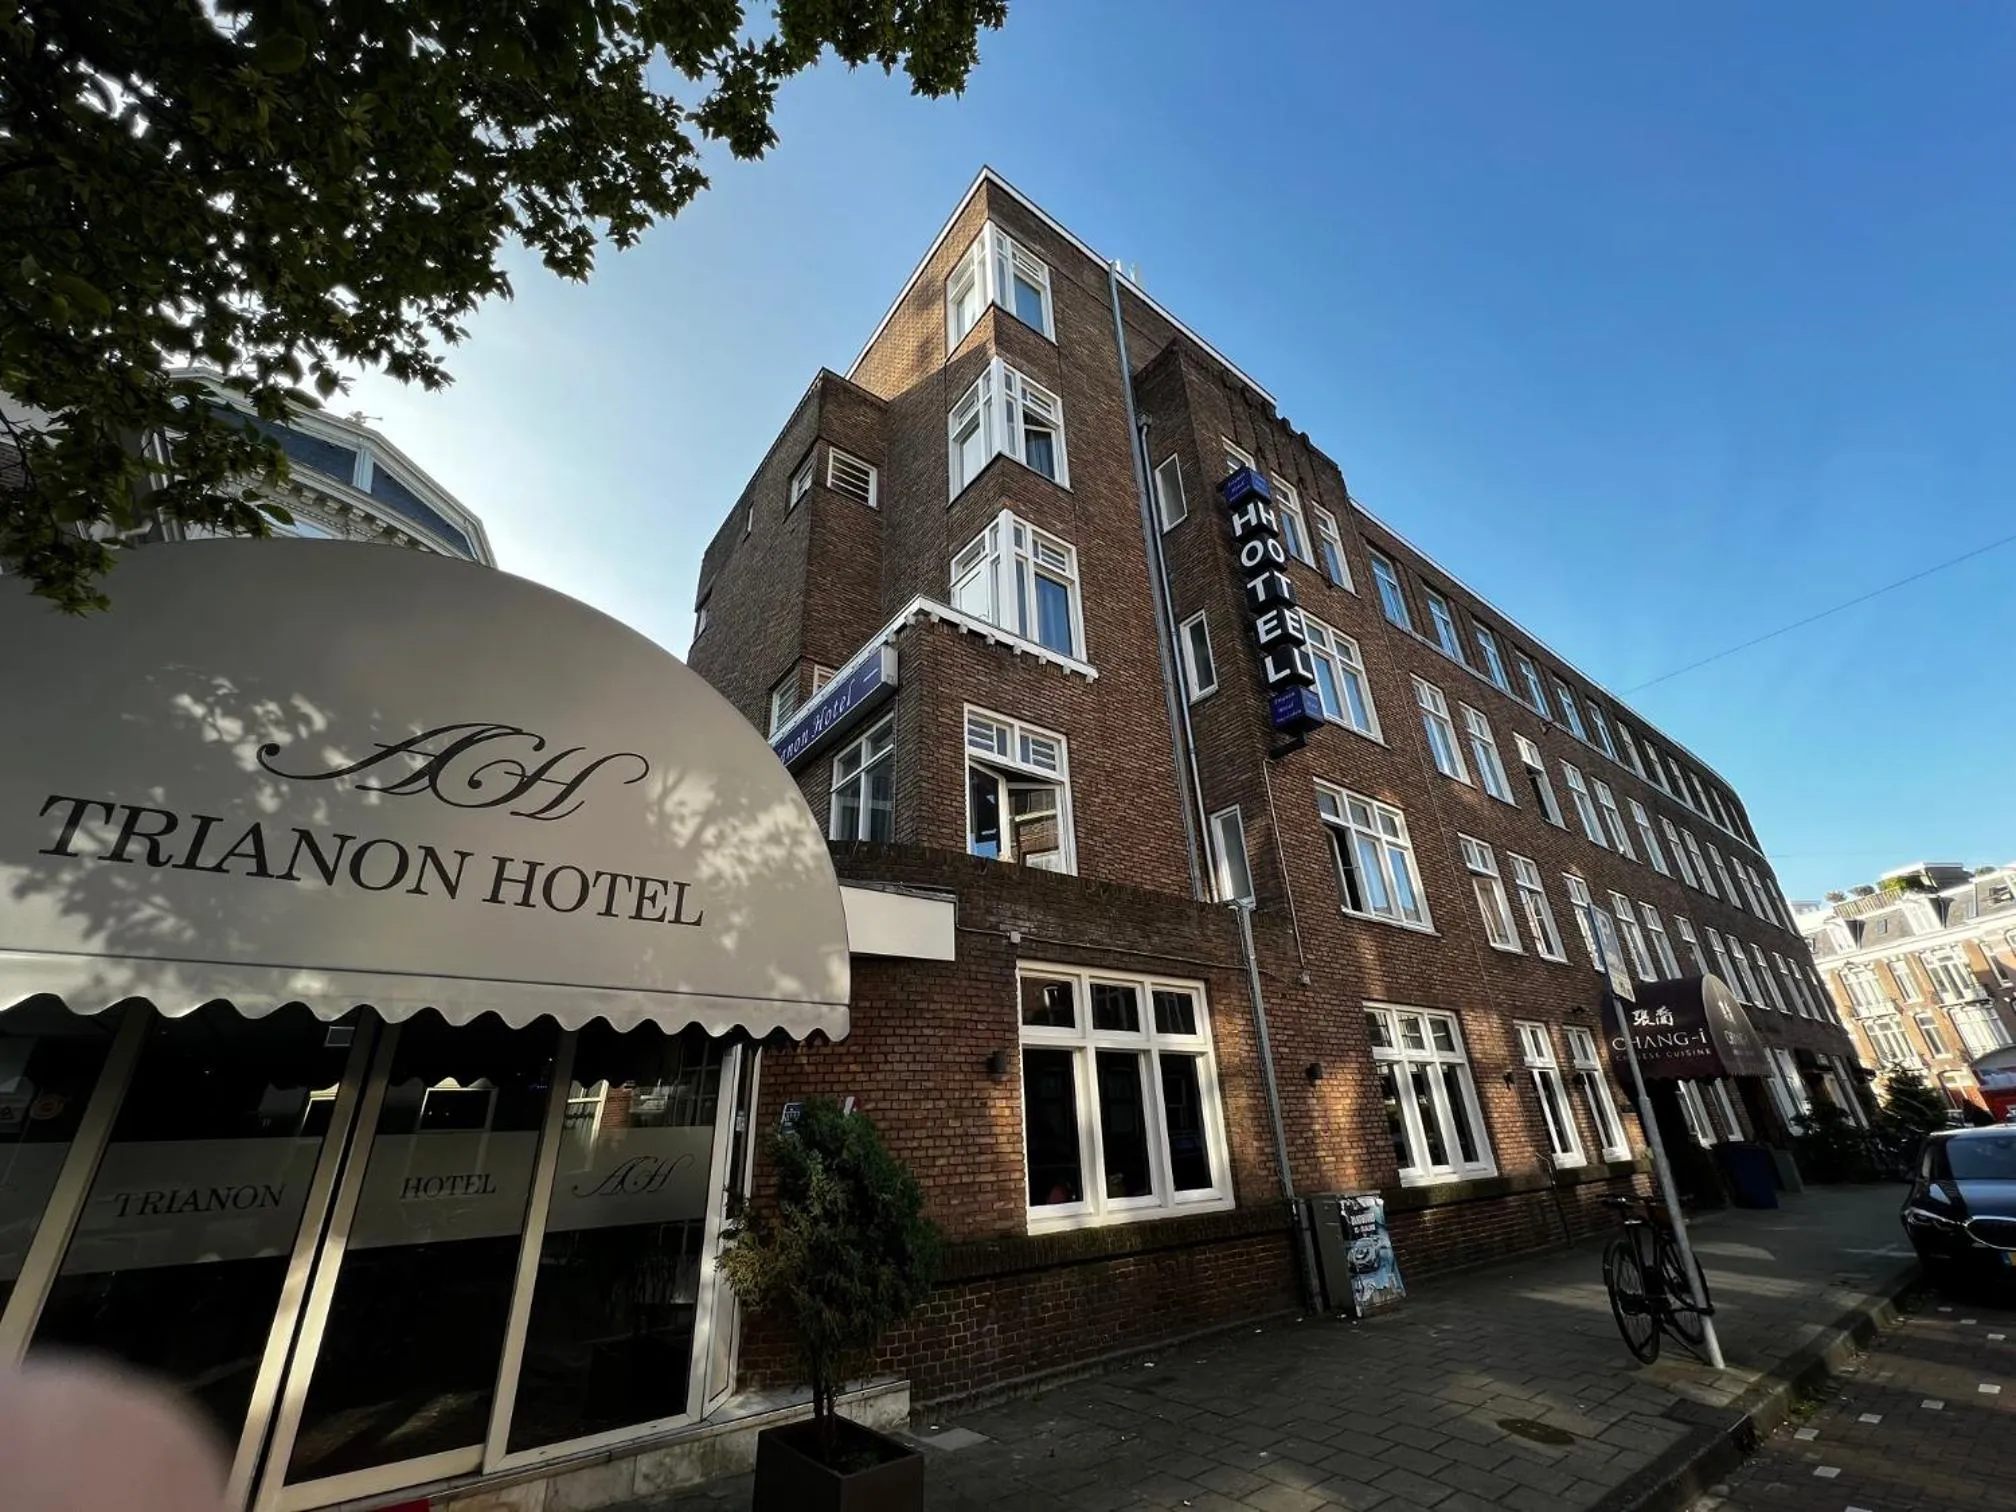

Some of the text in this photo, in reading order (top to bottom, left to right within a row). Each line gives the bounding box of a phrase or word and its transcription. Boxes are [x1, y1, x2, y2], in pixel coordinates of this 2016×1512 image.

[1231, 501, 1291, 684] HOTEL
[779, 678, 856, 763] anon Hotel
[37, 795, 705, 927] TRIANON HOTEL
[114, 1174, 497, 1217] TRIANON HOTEL
